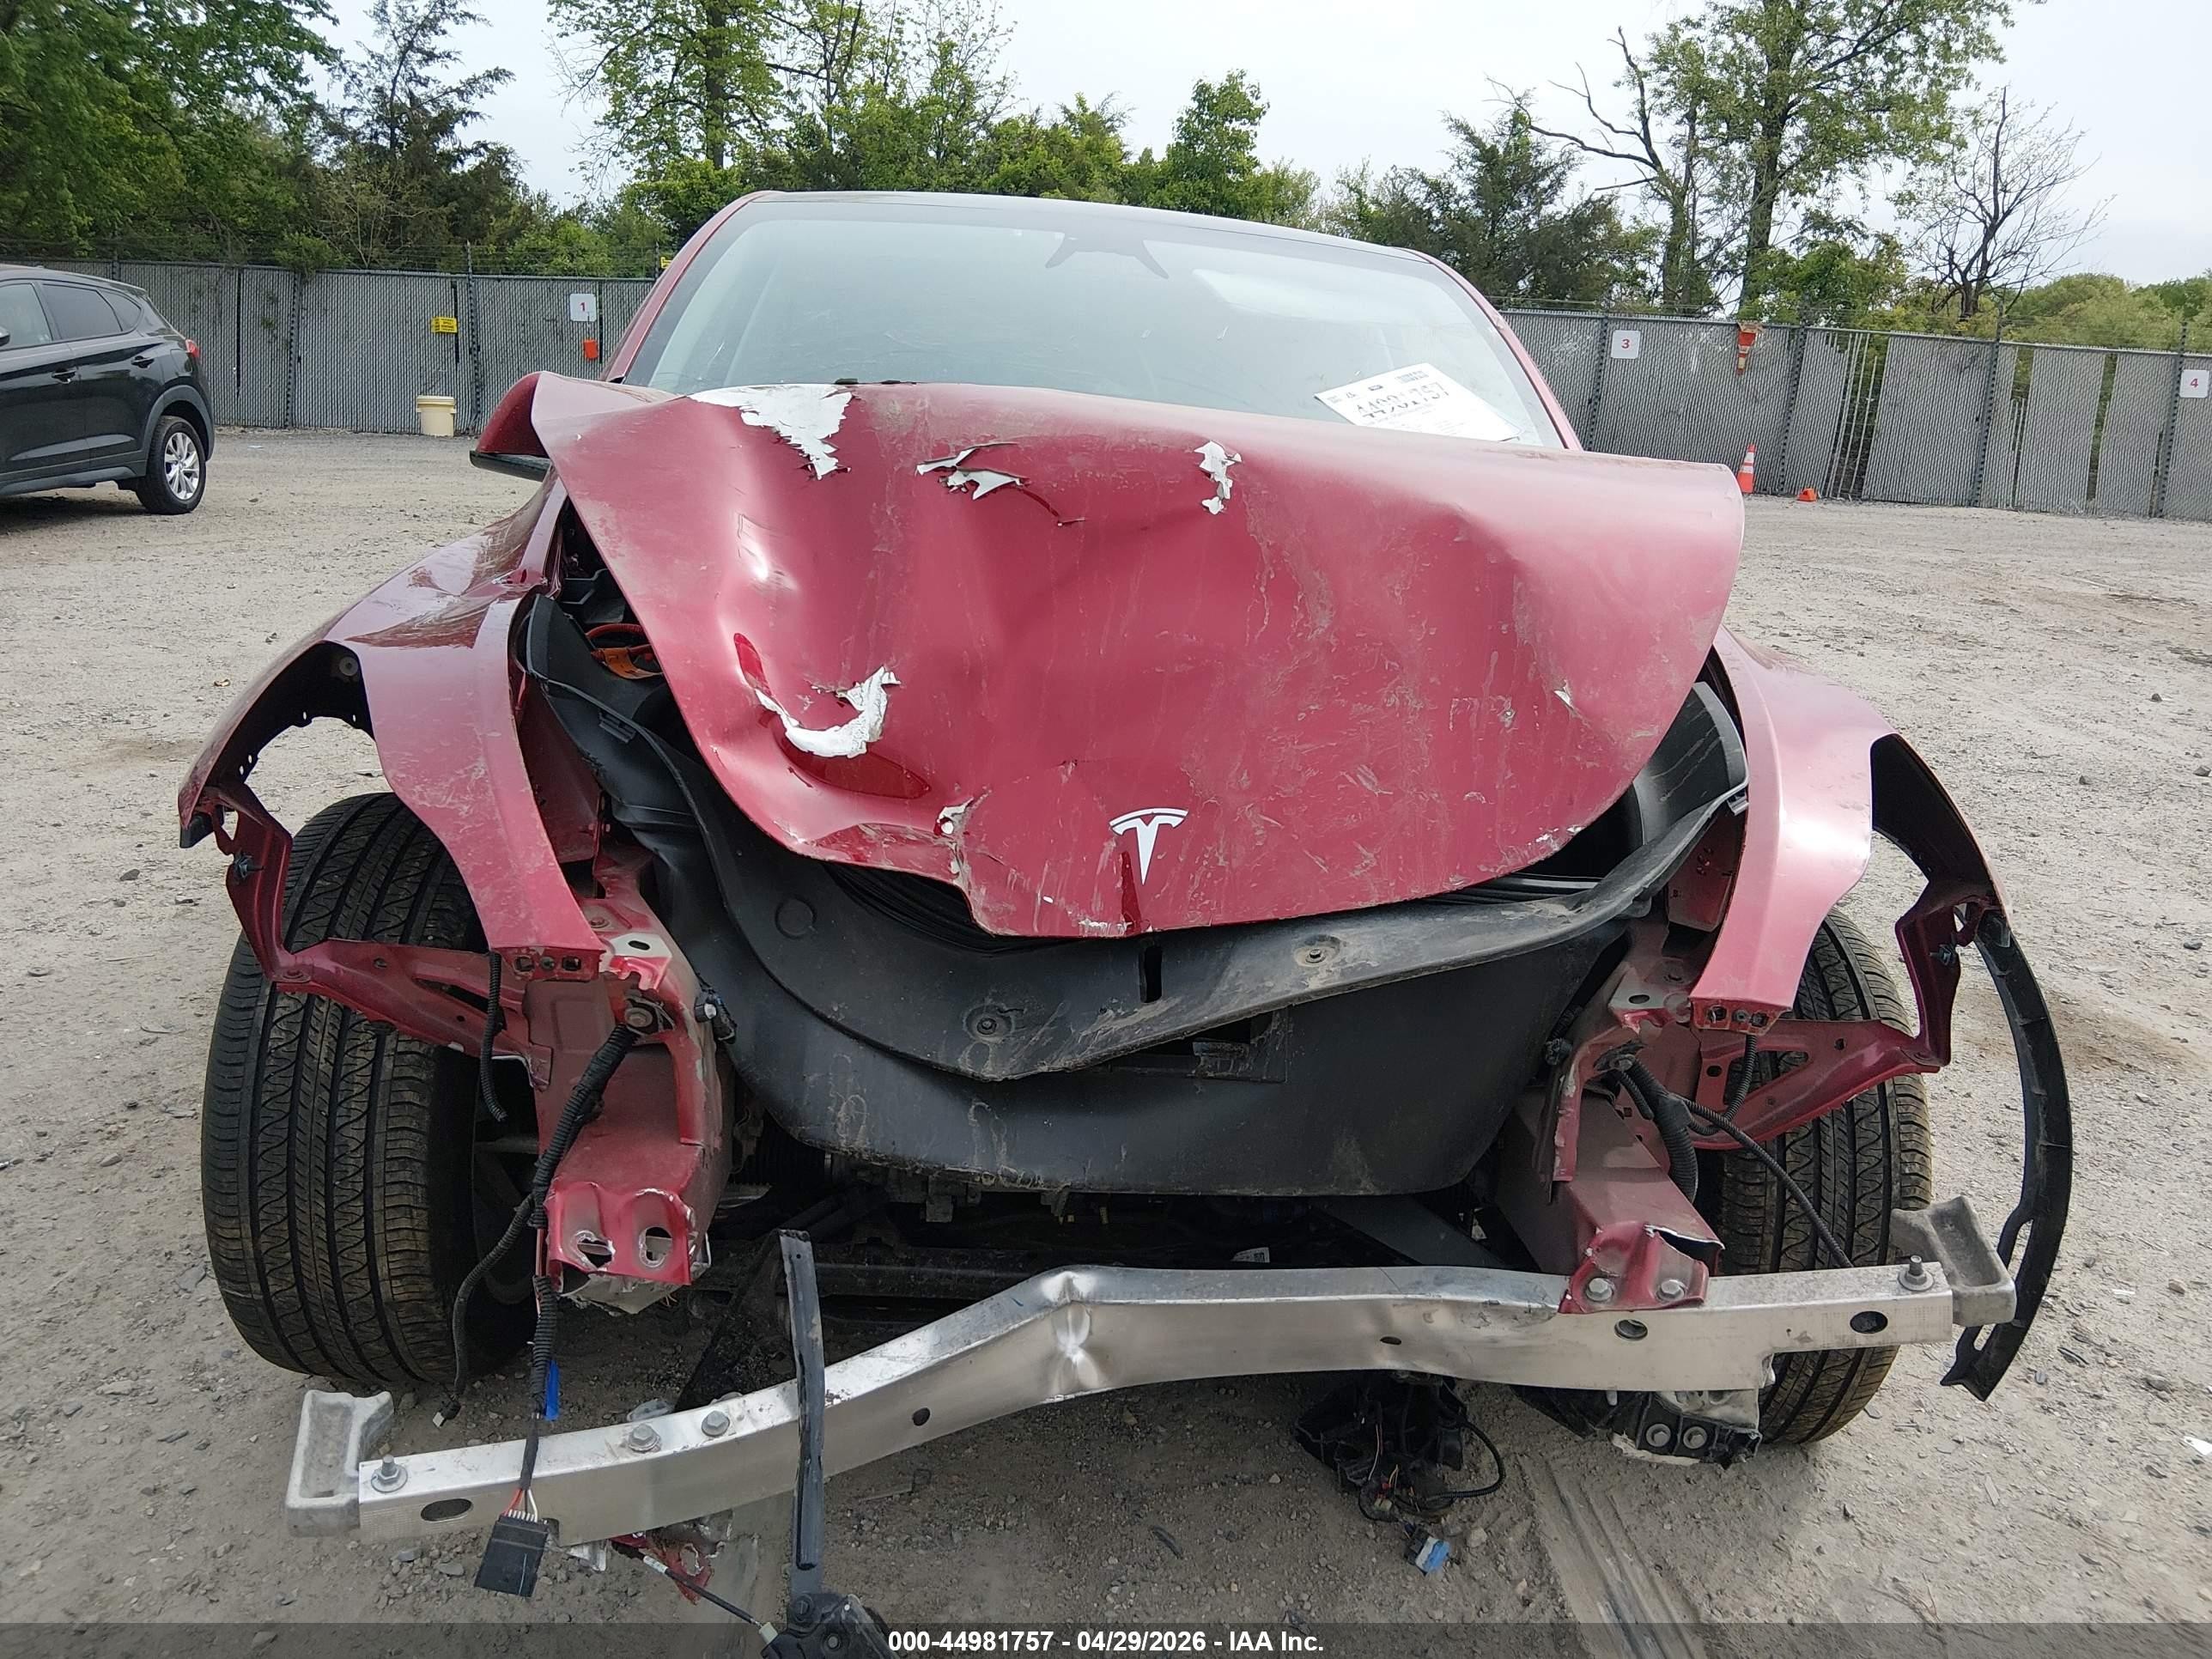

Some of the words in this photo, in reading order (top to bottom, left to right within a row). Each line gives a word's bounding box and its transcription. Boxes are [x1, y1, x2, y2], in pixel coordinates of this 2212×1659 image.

[580, 301, 586, 312] 1
[1621, 338, 1630, 349] 3
[2191, 378, 2199, 388] 4
